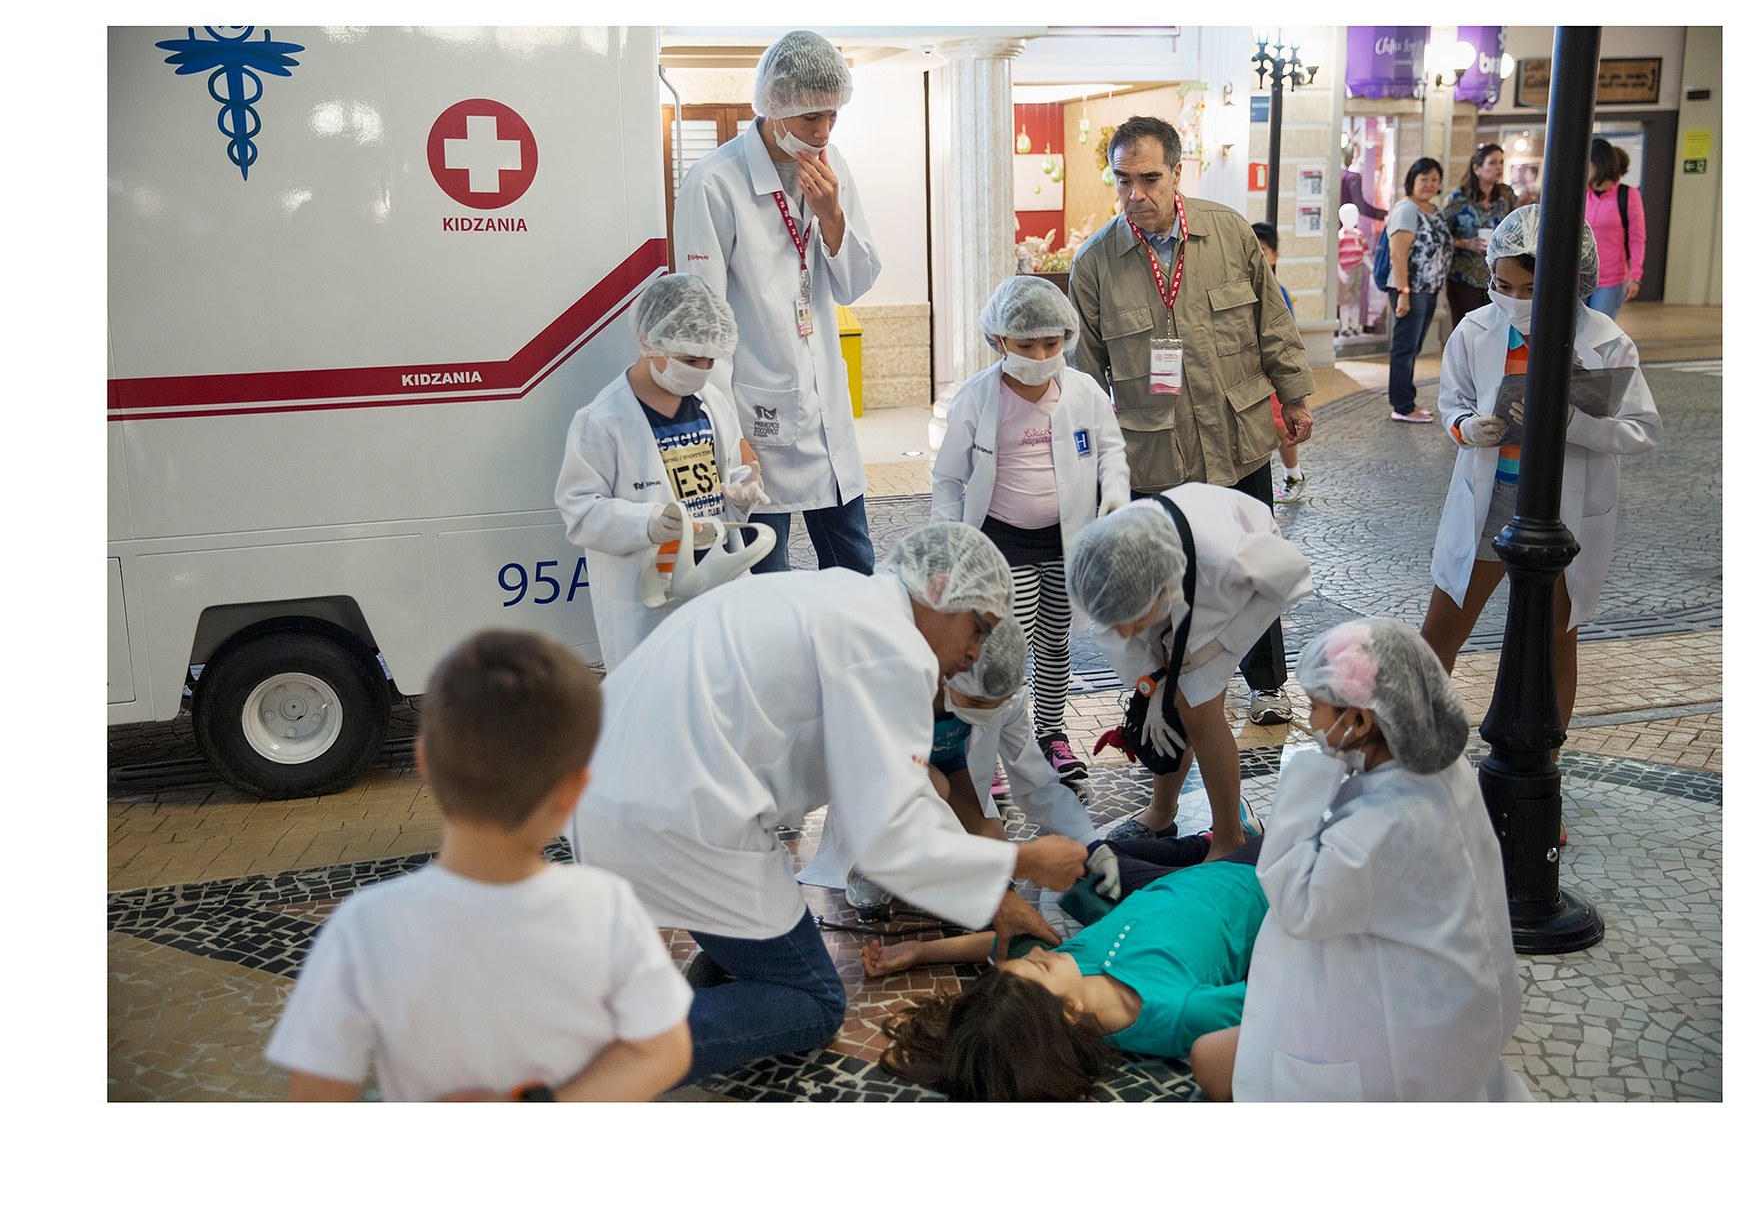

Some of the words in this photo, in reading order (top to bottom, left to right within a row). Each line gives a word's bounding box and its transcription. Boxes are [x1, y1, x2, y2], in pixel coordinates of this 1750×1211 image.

[442, 217, 528, 232] KIDZANIA
[401, 370, 483, 387] KIDZANIA
[497, 556, 590, 607] 95A
